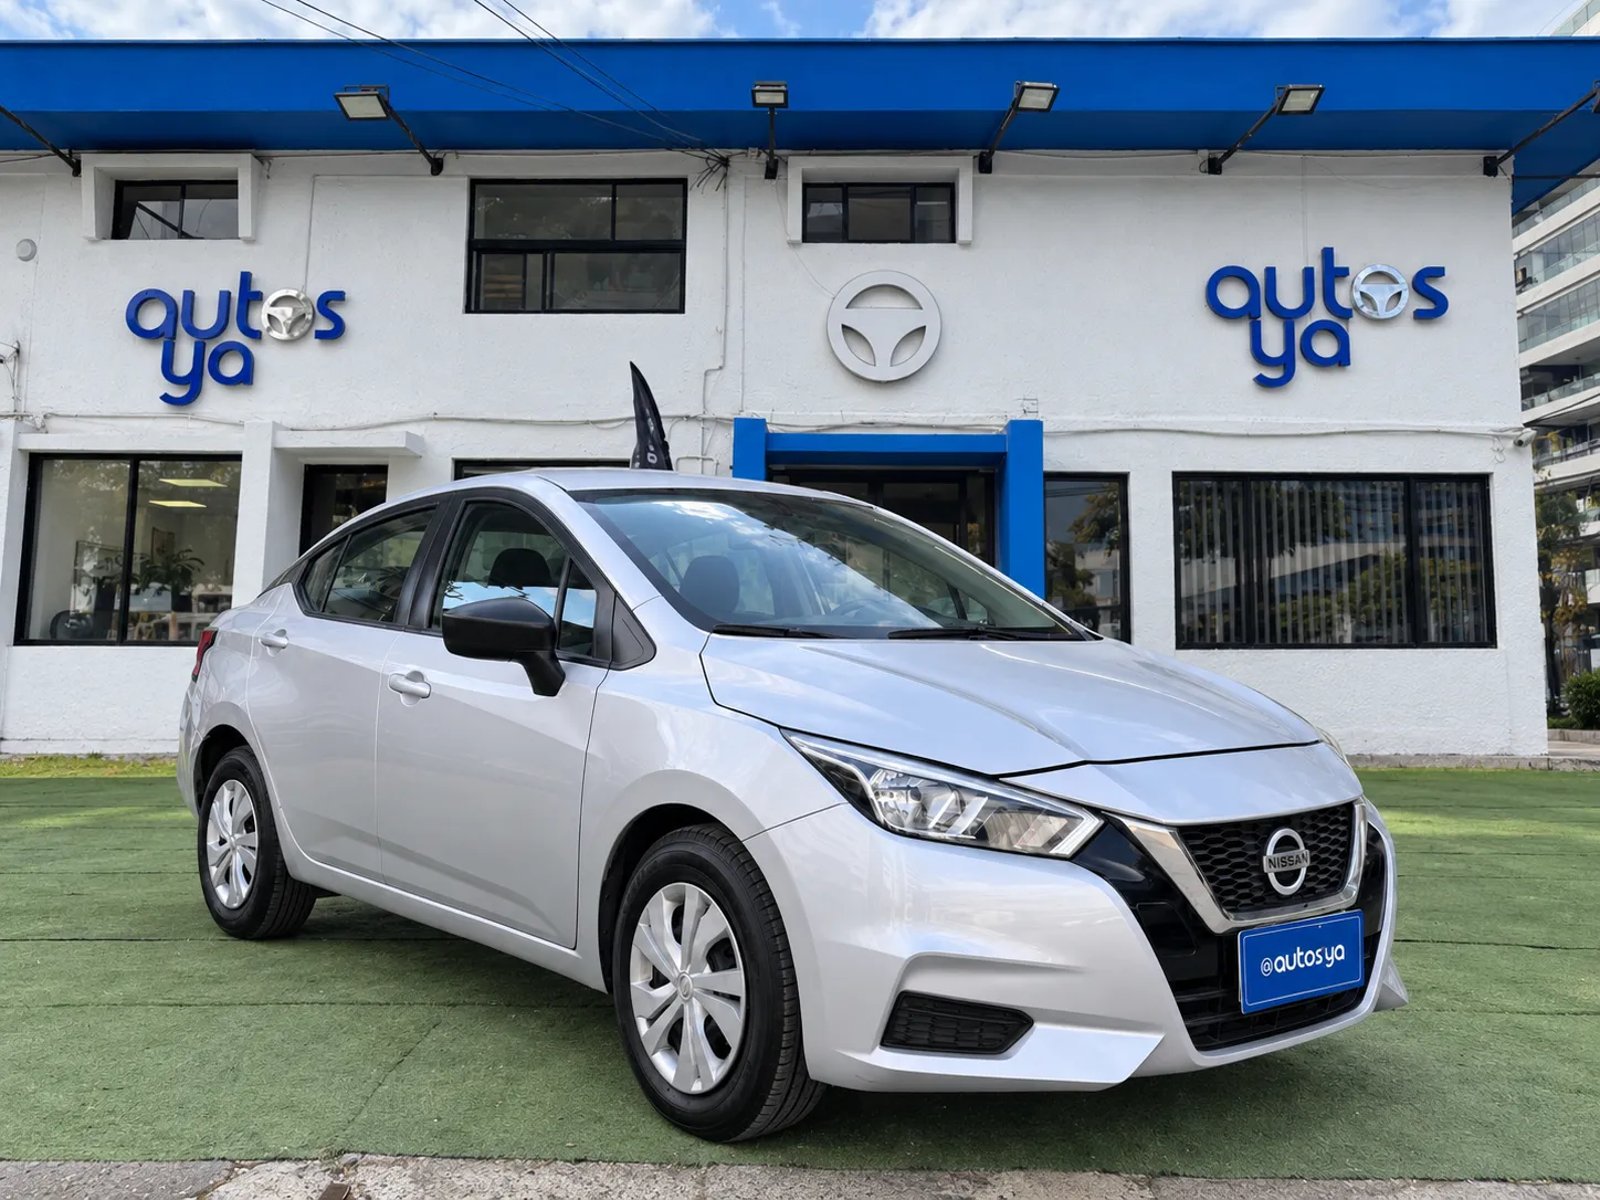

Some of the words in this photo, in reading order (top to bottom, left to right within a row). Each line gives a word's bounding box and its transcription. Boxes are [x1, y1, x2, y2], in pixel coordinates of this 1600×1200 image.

[125, 271, 346, 340] autos
[1206, 246, 1449, 321] autos
[159, 340, 254, 406] ya
[1249, 319, 1351, 388] ya
[1267, 851, 1308, 869] NISSAN
